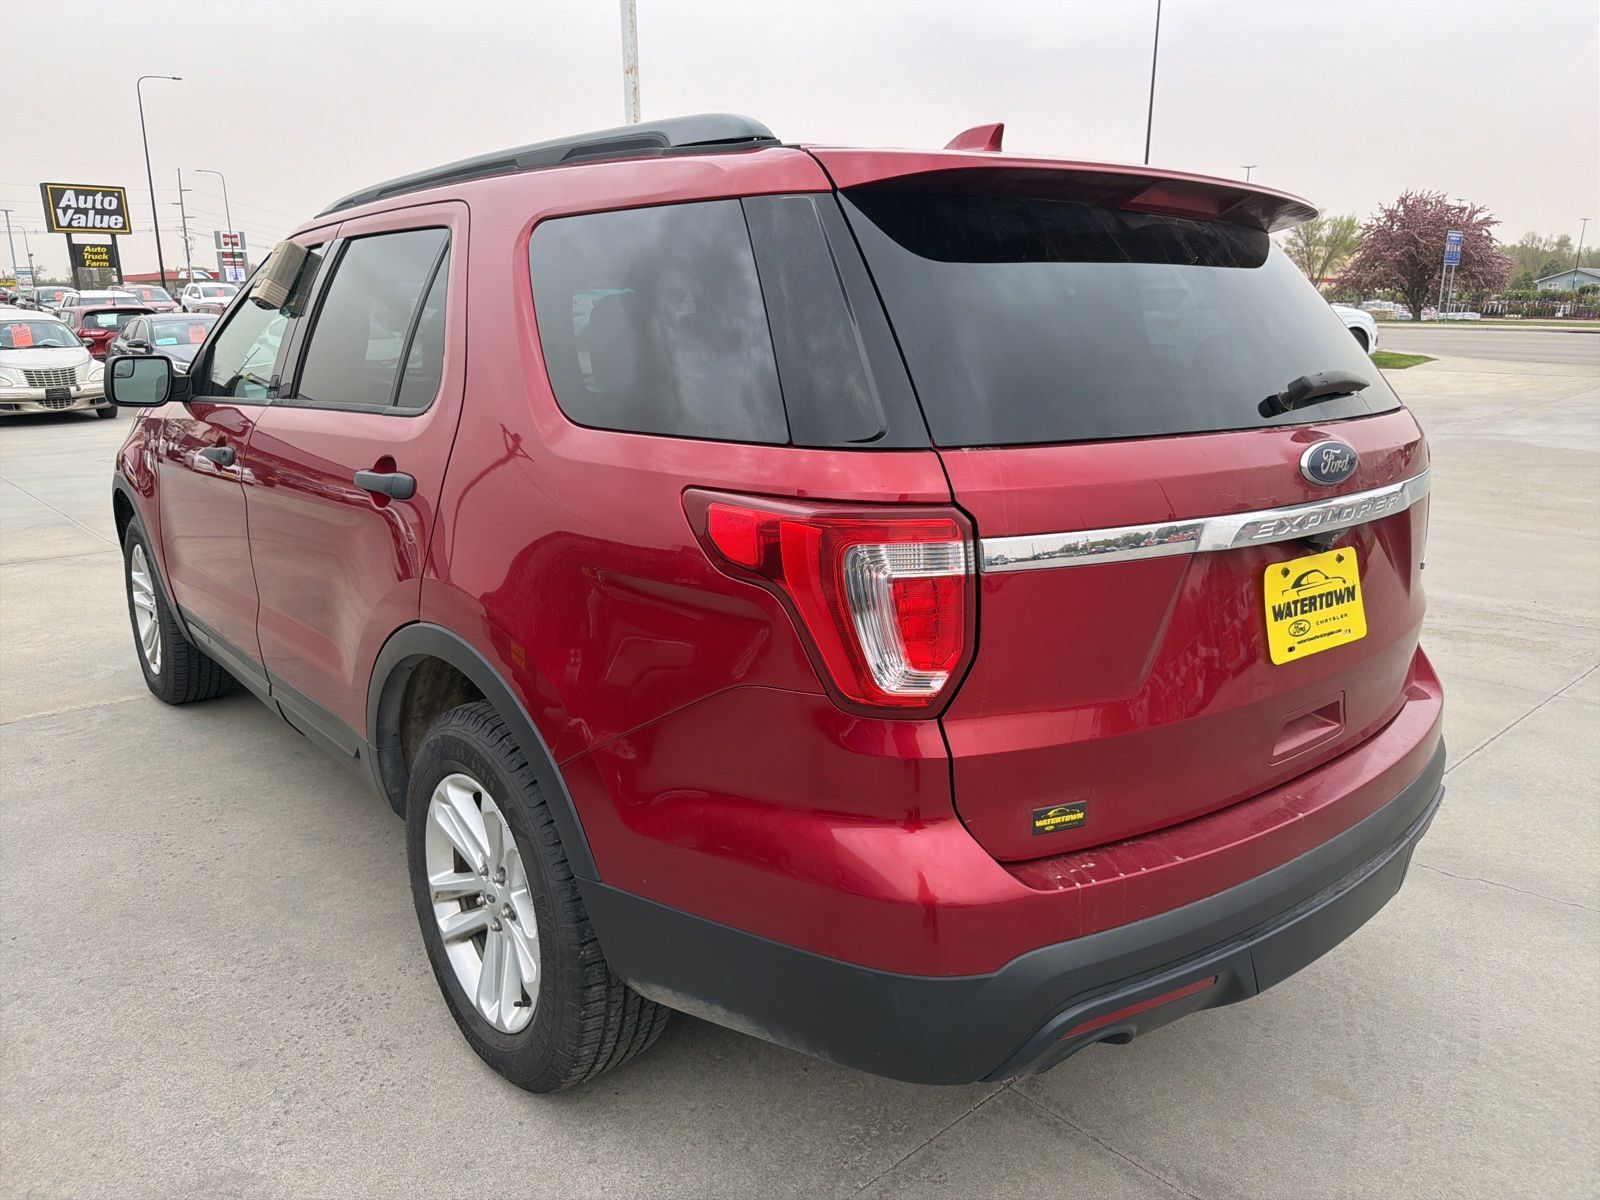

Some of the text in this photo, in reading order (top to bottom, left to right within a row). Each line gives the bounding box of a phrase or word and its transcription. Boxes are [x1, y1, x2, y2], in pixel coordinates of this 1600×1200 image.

[58, 189, 118, 210] Auto
[56, 208, 124, 229] Value
[82, 252, 109, 260] Truck
[83, 245, 107, 253] Auto
[85, 259, 109, 267] Farm
[1320, 448, 1350, 475] Ford
[1251, 494, 1400, 540] EXPLORER
[1271, 585, 1357, 622] WATERTOWN
[1315, 612, 1348, 626] CHRYSLER
[1035, 811, 1084, 827] WATERTOWN
